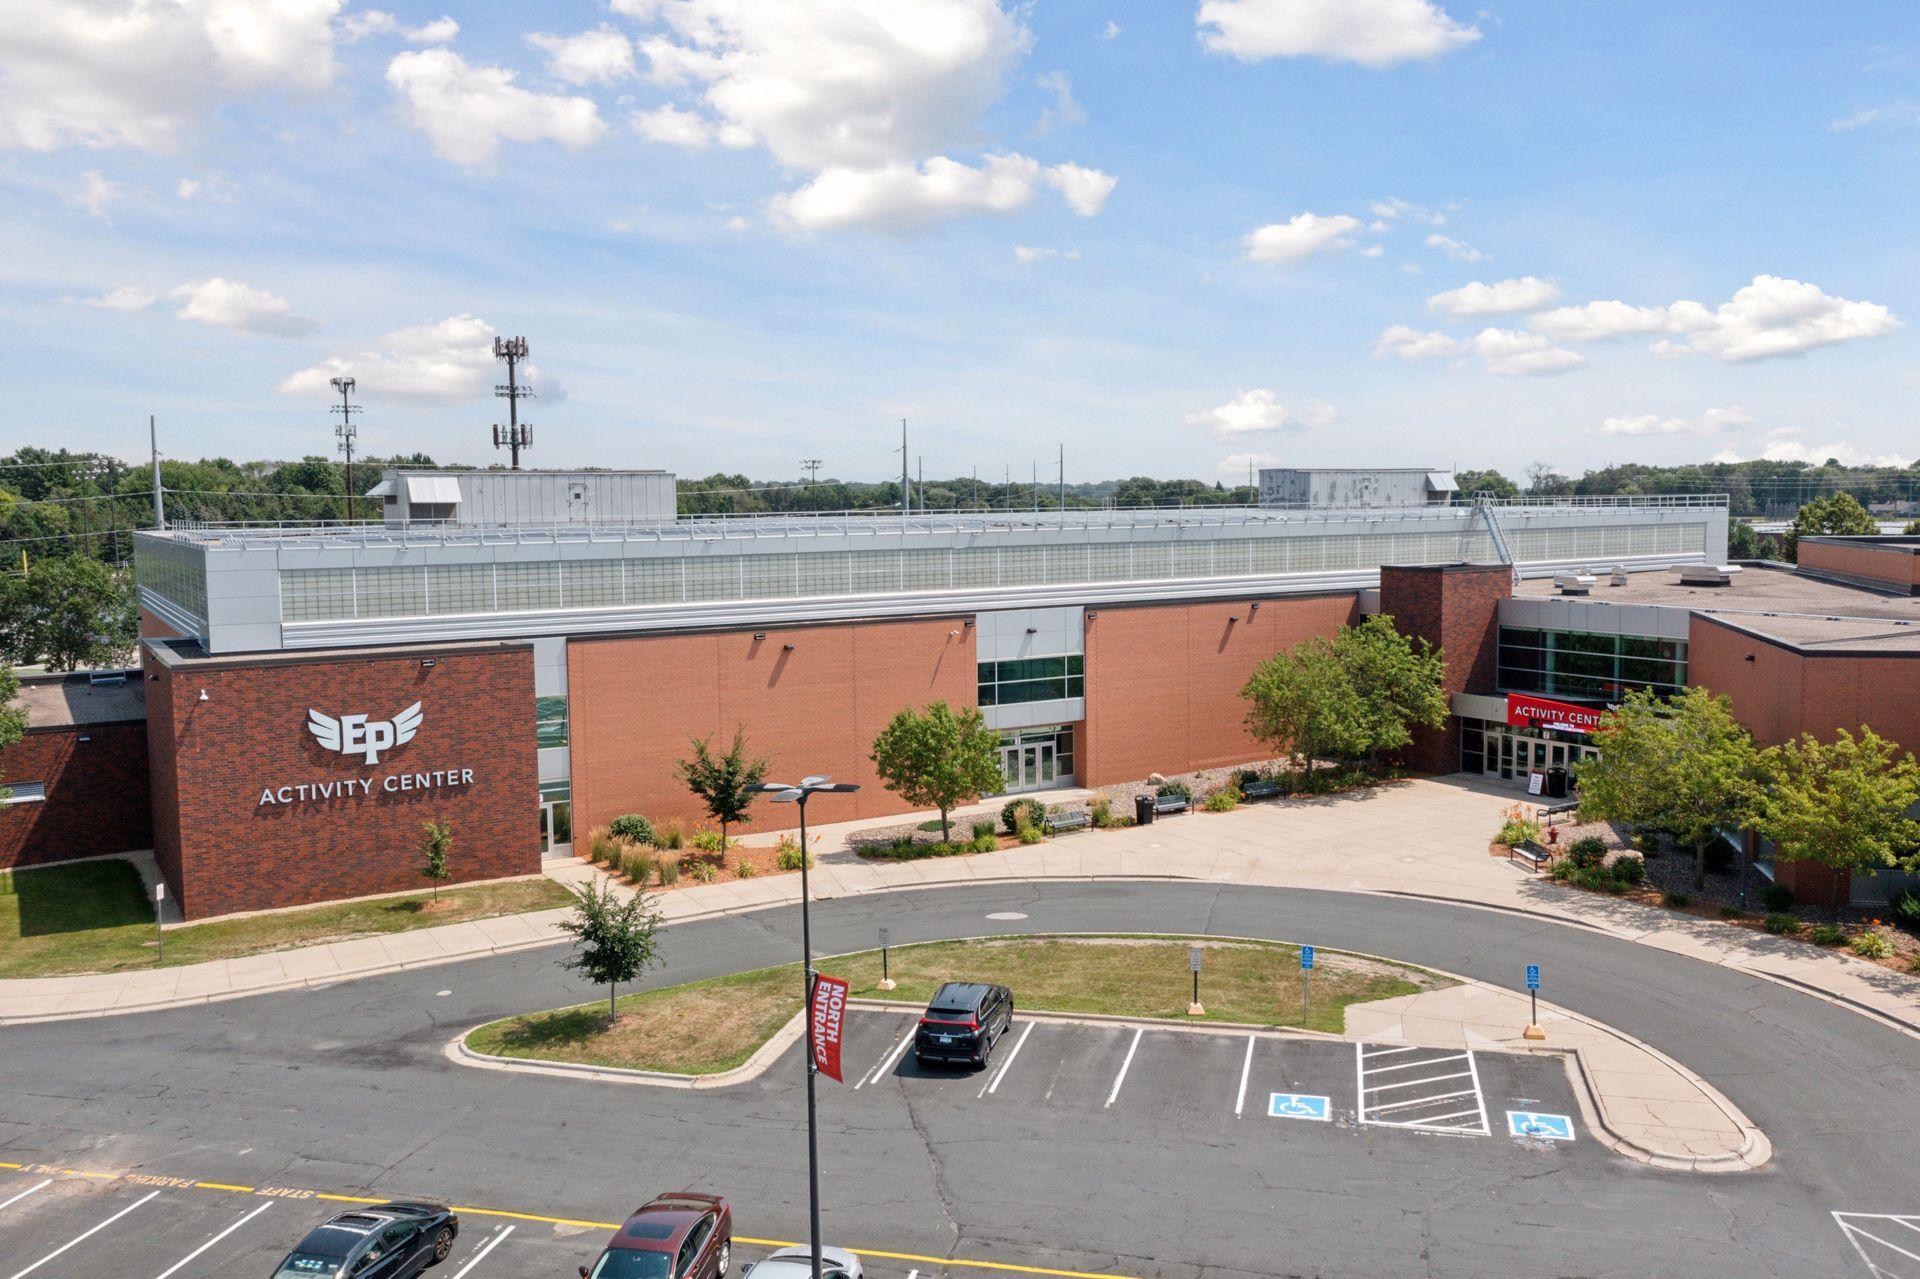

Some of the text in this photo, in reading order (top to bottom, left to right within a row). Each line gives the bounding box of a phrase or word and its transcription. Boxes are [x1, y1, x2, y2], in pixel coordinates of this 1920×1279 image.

[1515, 706, 1603, 726] ACTIVITY CENT
[259, 768, 474, 805] ACTIVITY CENTER
[815, 981, 831, 1066] ENTRANCE
[826, 984, 844, 1043] NORTH
[255, 1187, 315, 1199] STAFF
